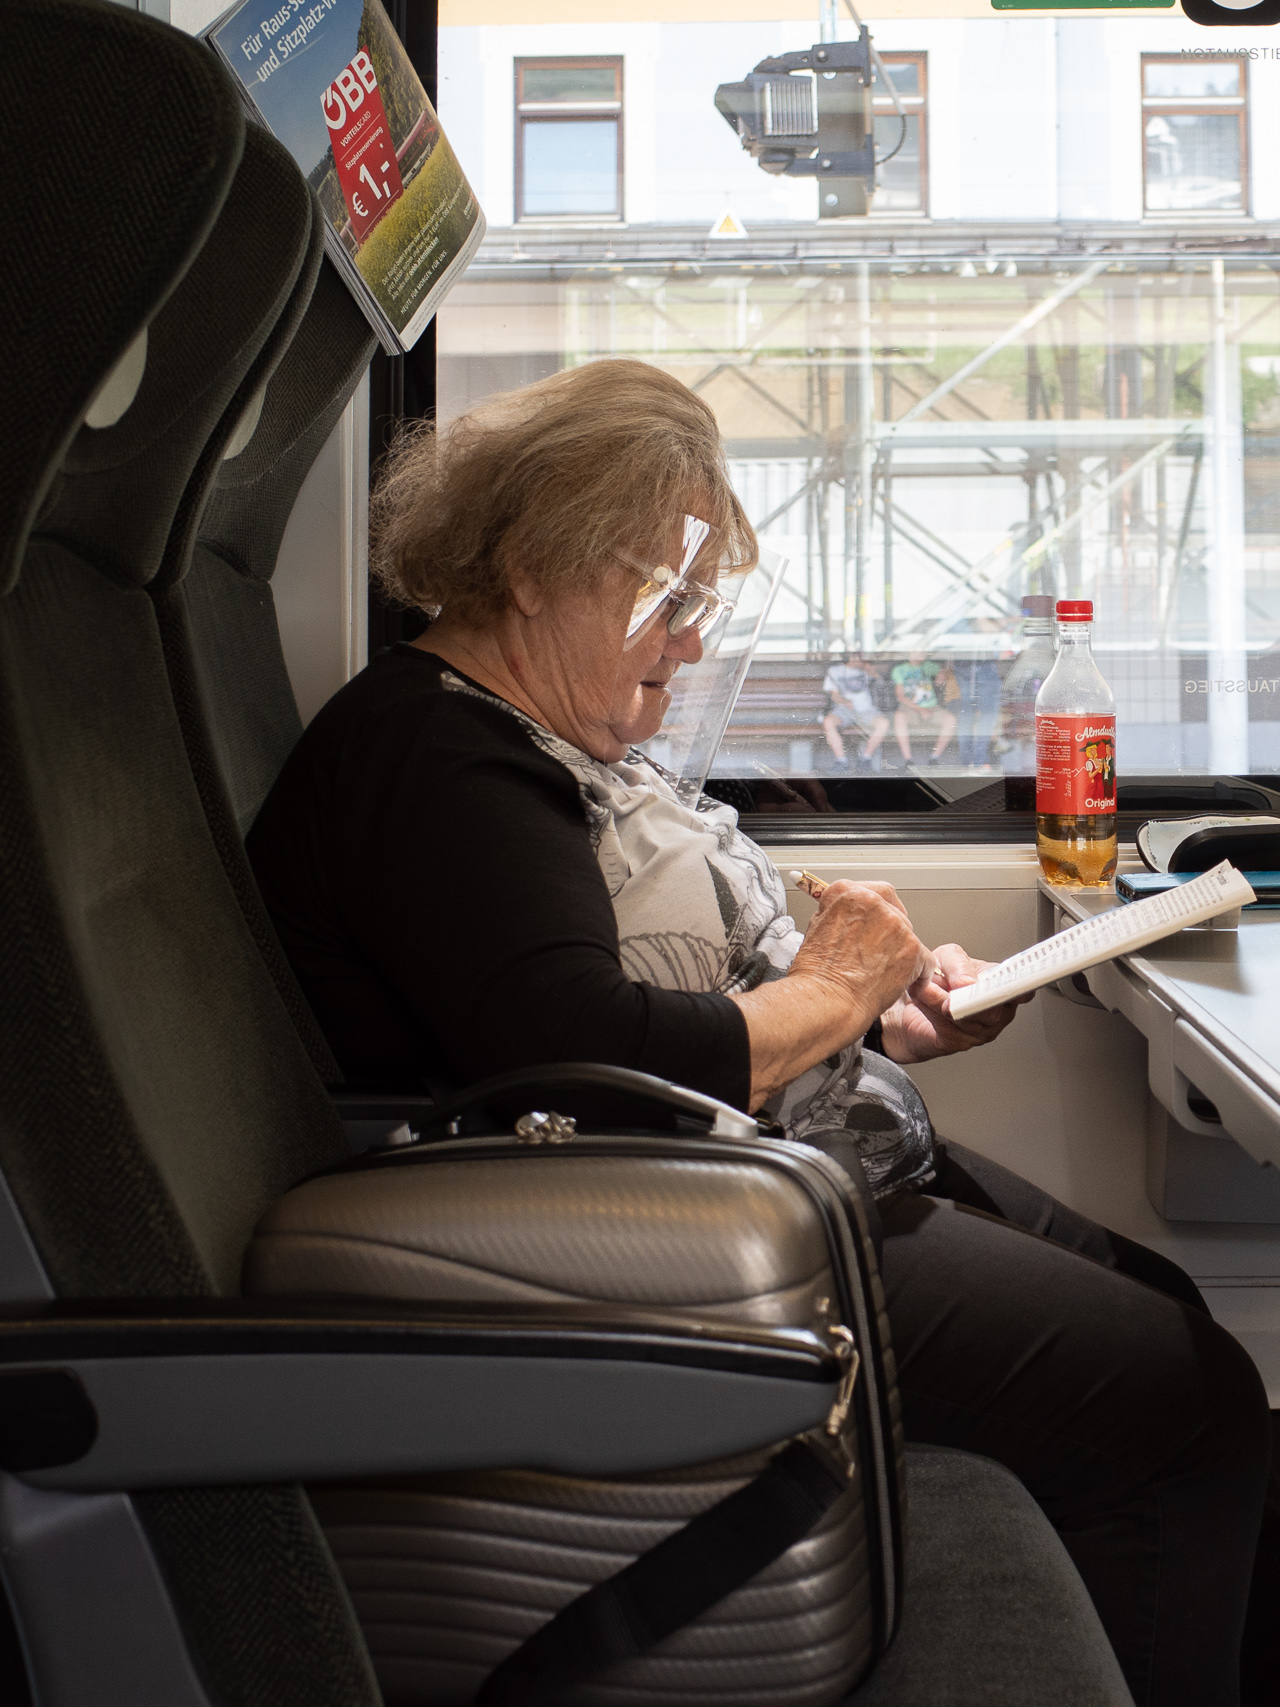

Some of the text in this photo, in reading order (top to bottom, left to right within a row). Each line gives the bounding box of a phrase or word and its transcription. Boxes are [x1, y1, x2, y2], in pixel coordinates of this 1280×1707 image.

[241, 33, 263, 60] Für
[256, 48, 280, 82] und
[320, 51, 378, 130] ÖBB
[340, 111, 371, 147] VORTEILSCARD
[345, 126, 384, 170] Sitzplatzreservierung
